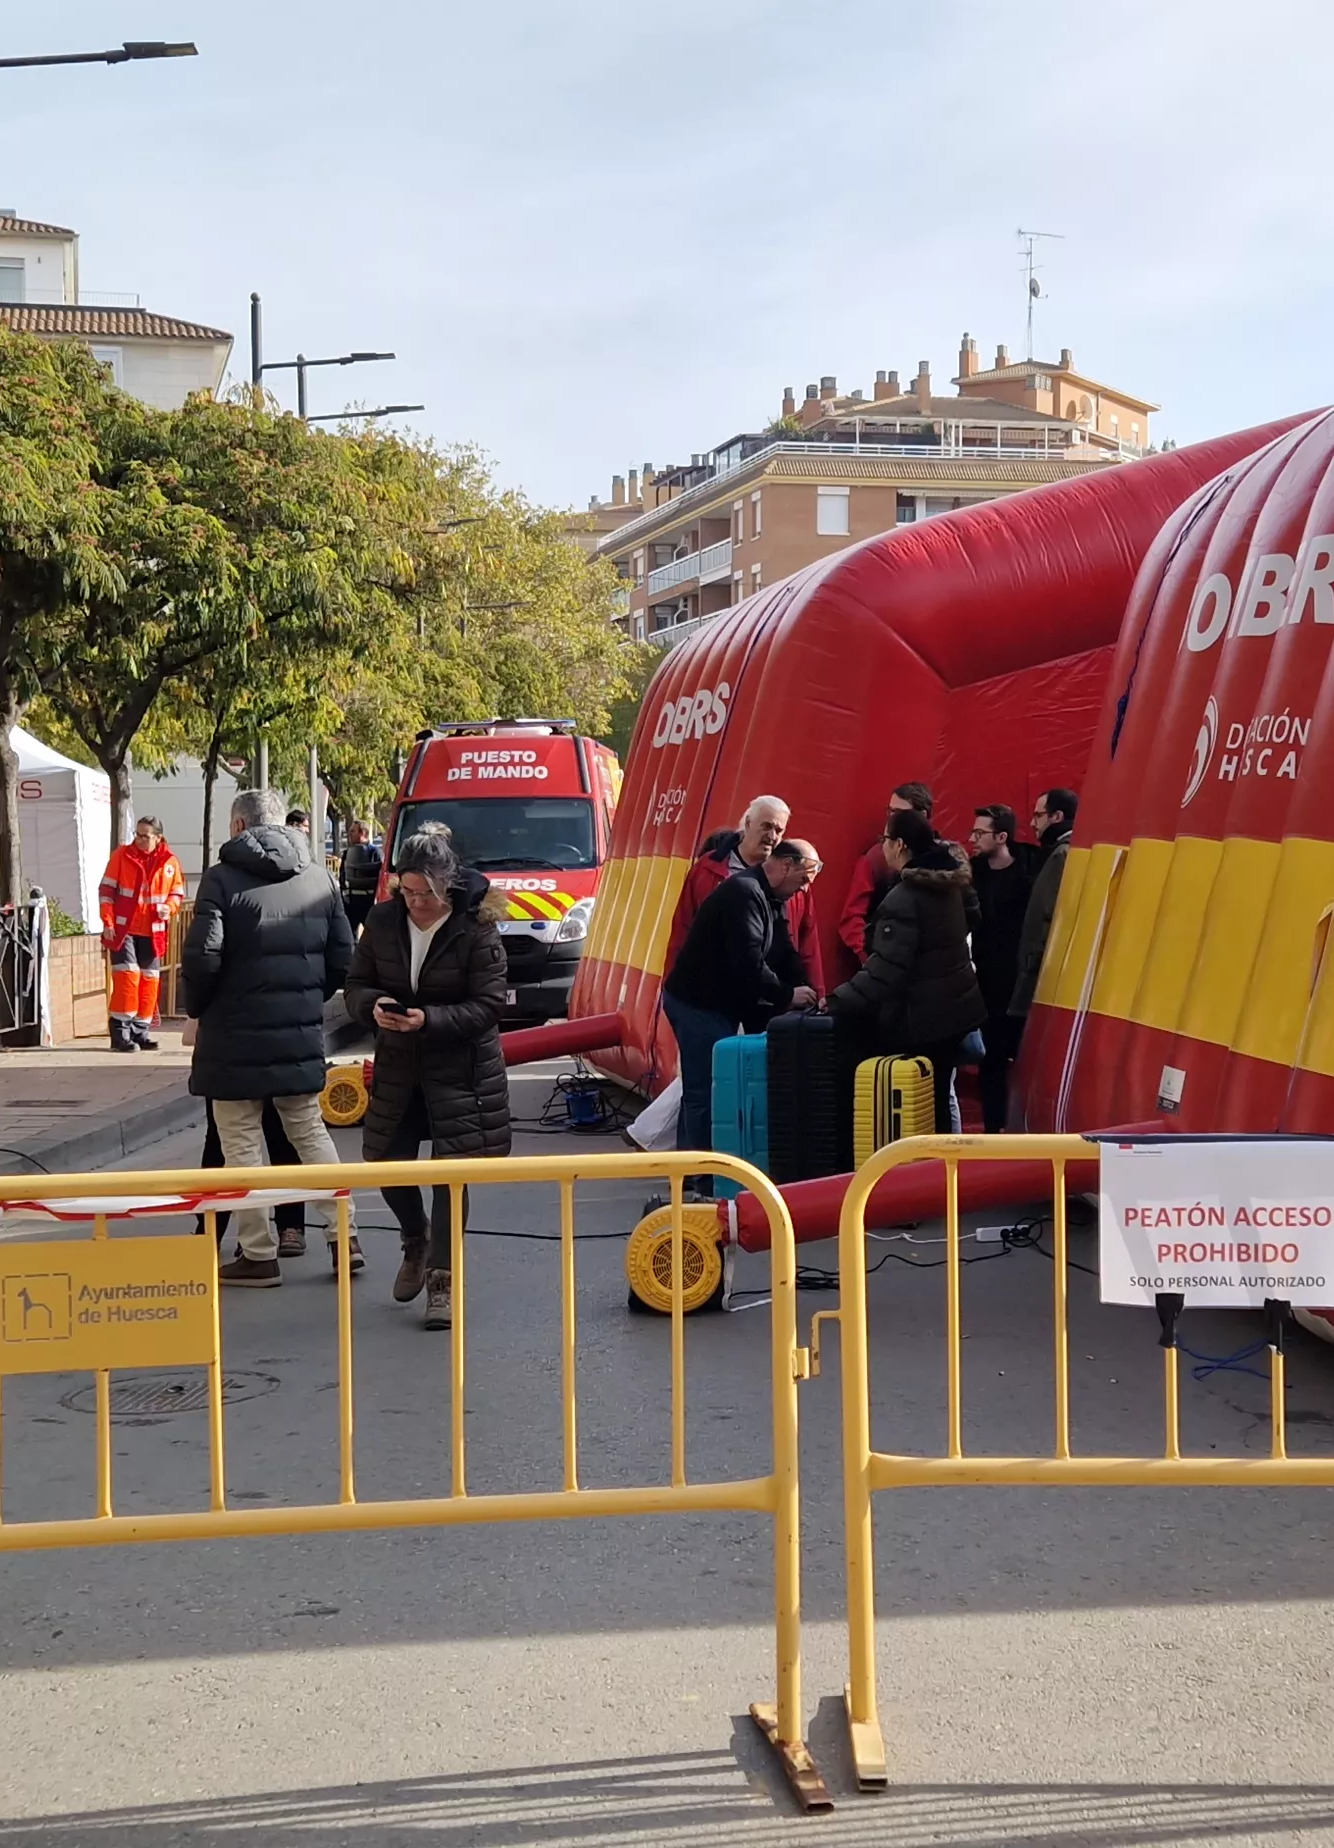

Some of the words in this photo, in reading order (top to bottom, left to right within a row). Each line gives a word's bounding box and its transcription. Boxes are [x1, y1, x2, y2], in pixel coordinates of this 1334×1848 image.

[652, 682, 730, 749] OBRS
[461, 750, 537, 764] PUESTO
[447, 767, 472, 781] DE
[477, 766, 548, 779] MANDO
[490, 878, 557, 891] EROS
[1124, 1202, 1225, 1228] PEATÓN
[1233, 1206, 1332, 1227] ACCESO
[1157, 1243, 1299, 1263] PROHIBIDO
[1130, 1276, 1164, 1288] SOLO
[1168, 1276, 1235, 1288] PERSONAL
[1238, 1276, 1326, 1288] AUTORIZADO
[78, 1280, 207, 1304] Ayuntamiento
[78, 1307, 101, 1324] de
[107, 1307, 178, 1323] Huesca
